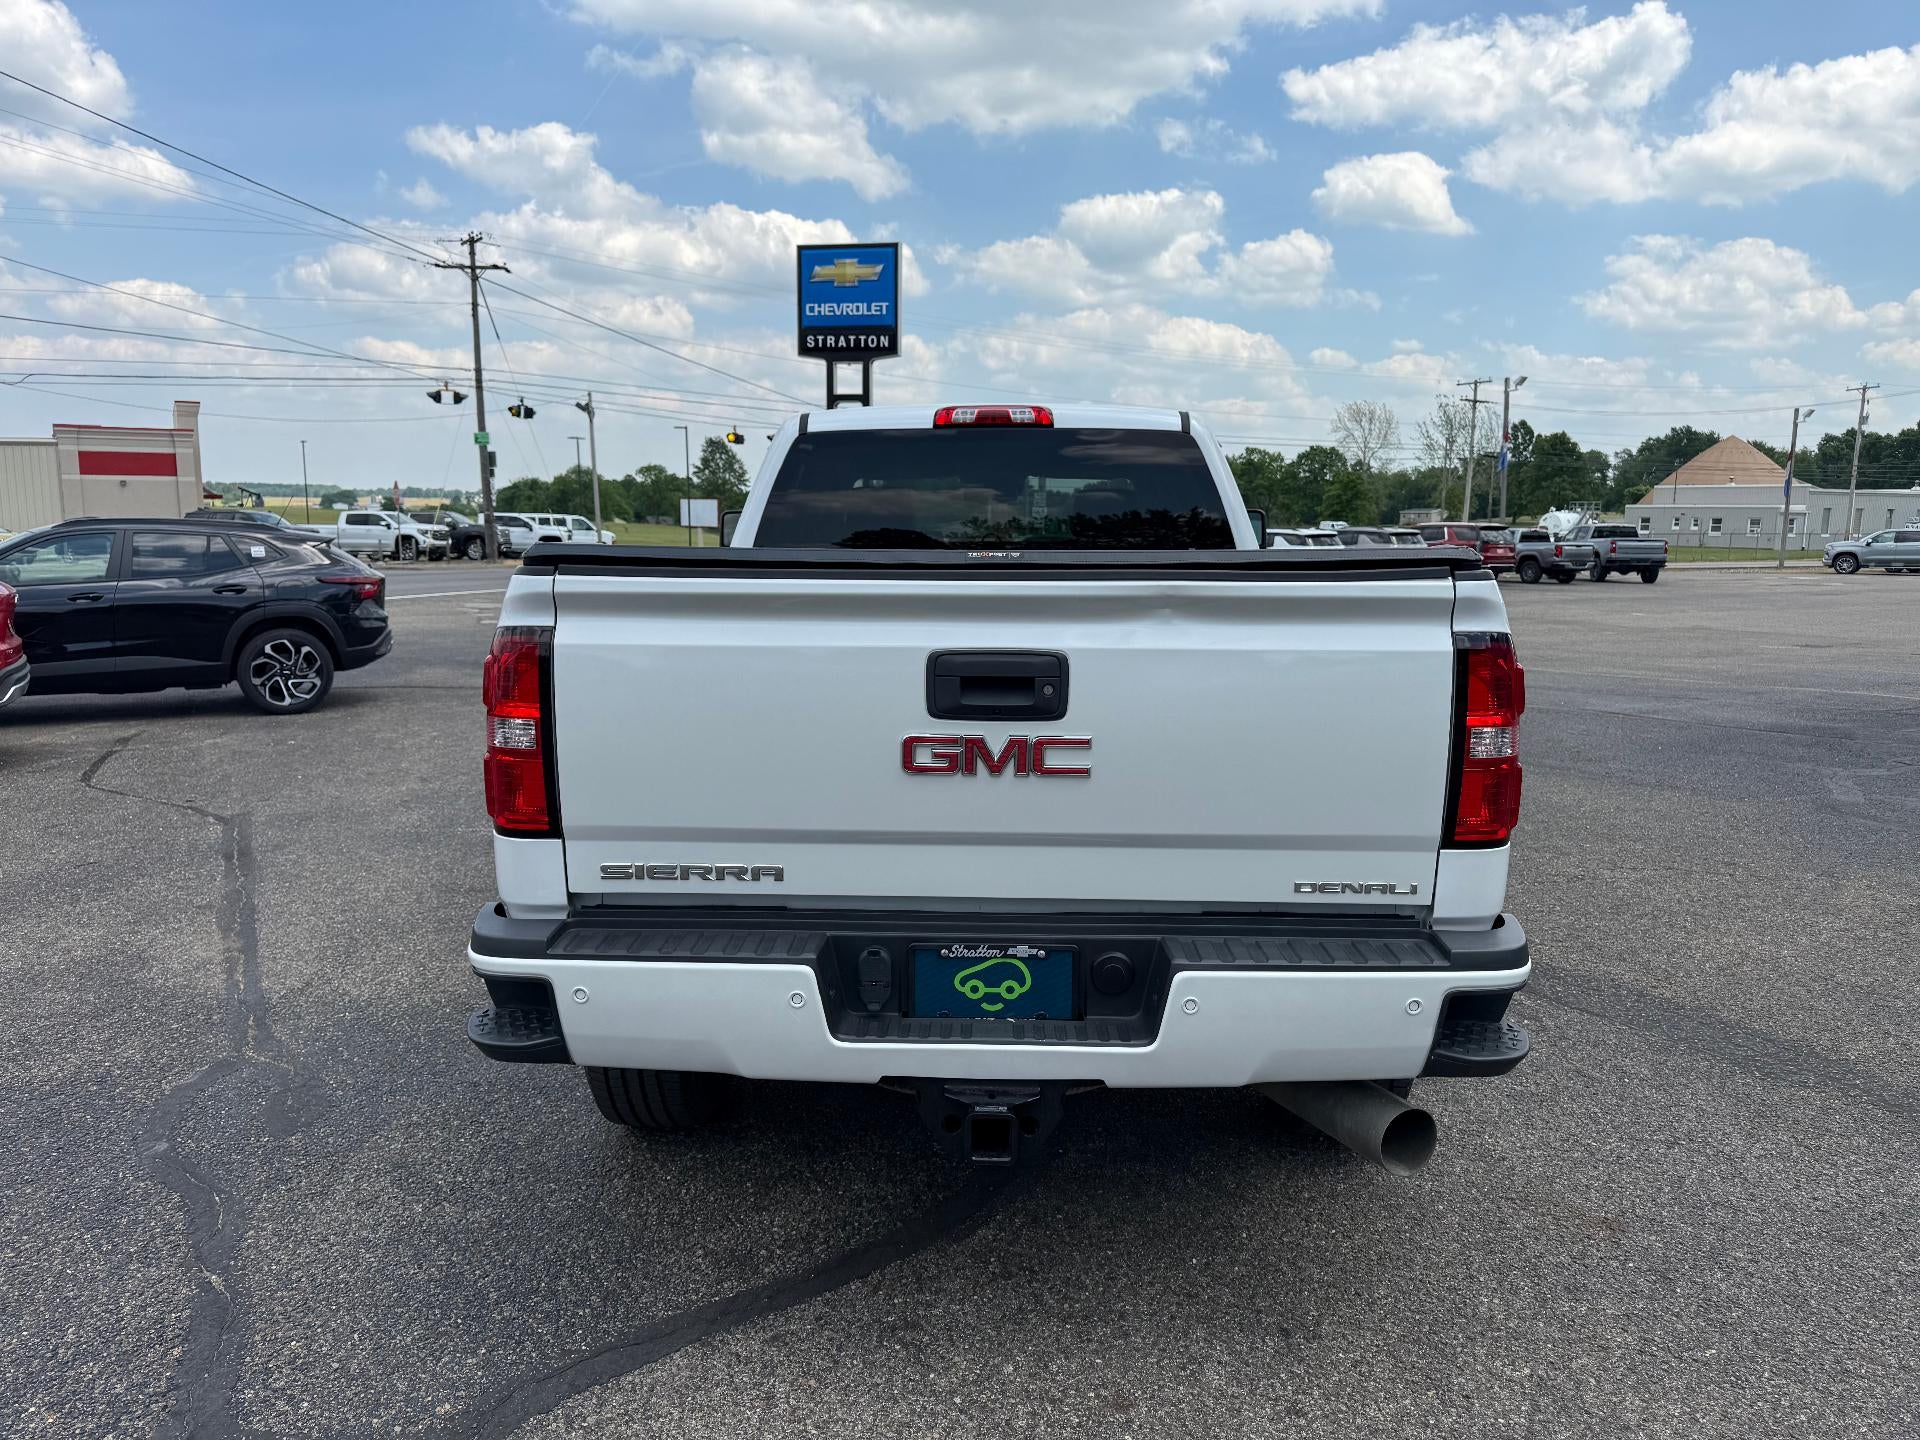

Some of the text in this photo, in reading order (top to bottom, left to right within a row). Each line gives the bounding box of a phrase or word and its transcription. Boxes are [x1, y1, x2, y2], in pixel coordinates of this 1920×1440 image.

[806, 302, 889, 316] CHEVROLET
[807, 335, 889, 348] STRATTON
[902, 734, 1092, 777] GMC
[600, 863, 784, 882] SIERRA
[1294, 881, 1418, 895] DENALI
[949, 944, 1004, 958] Stratton
